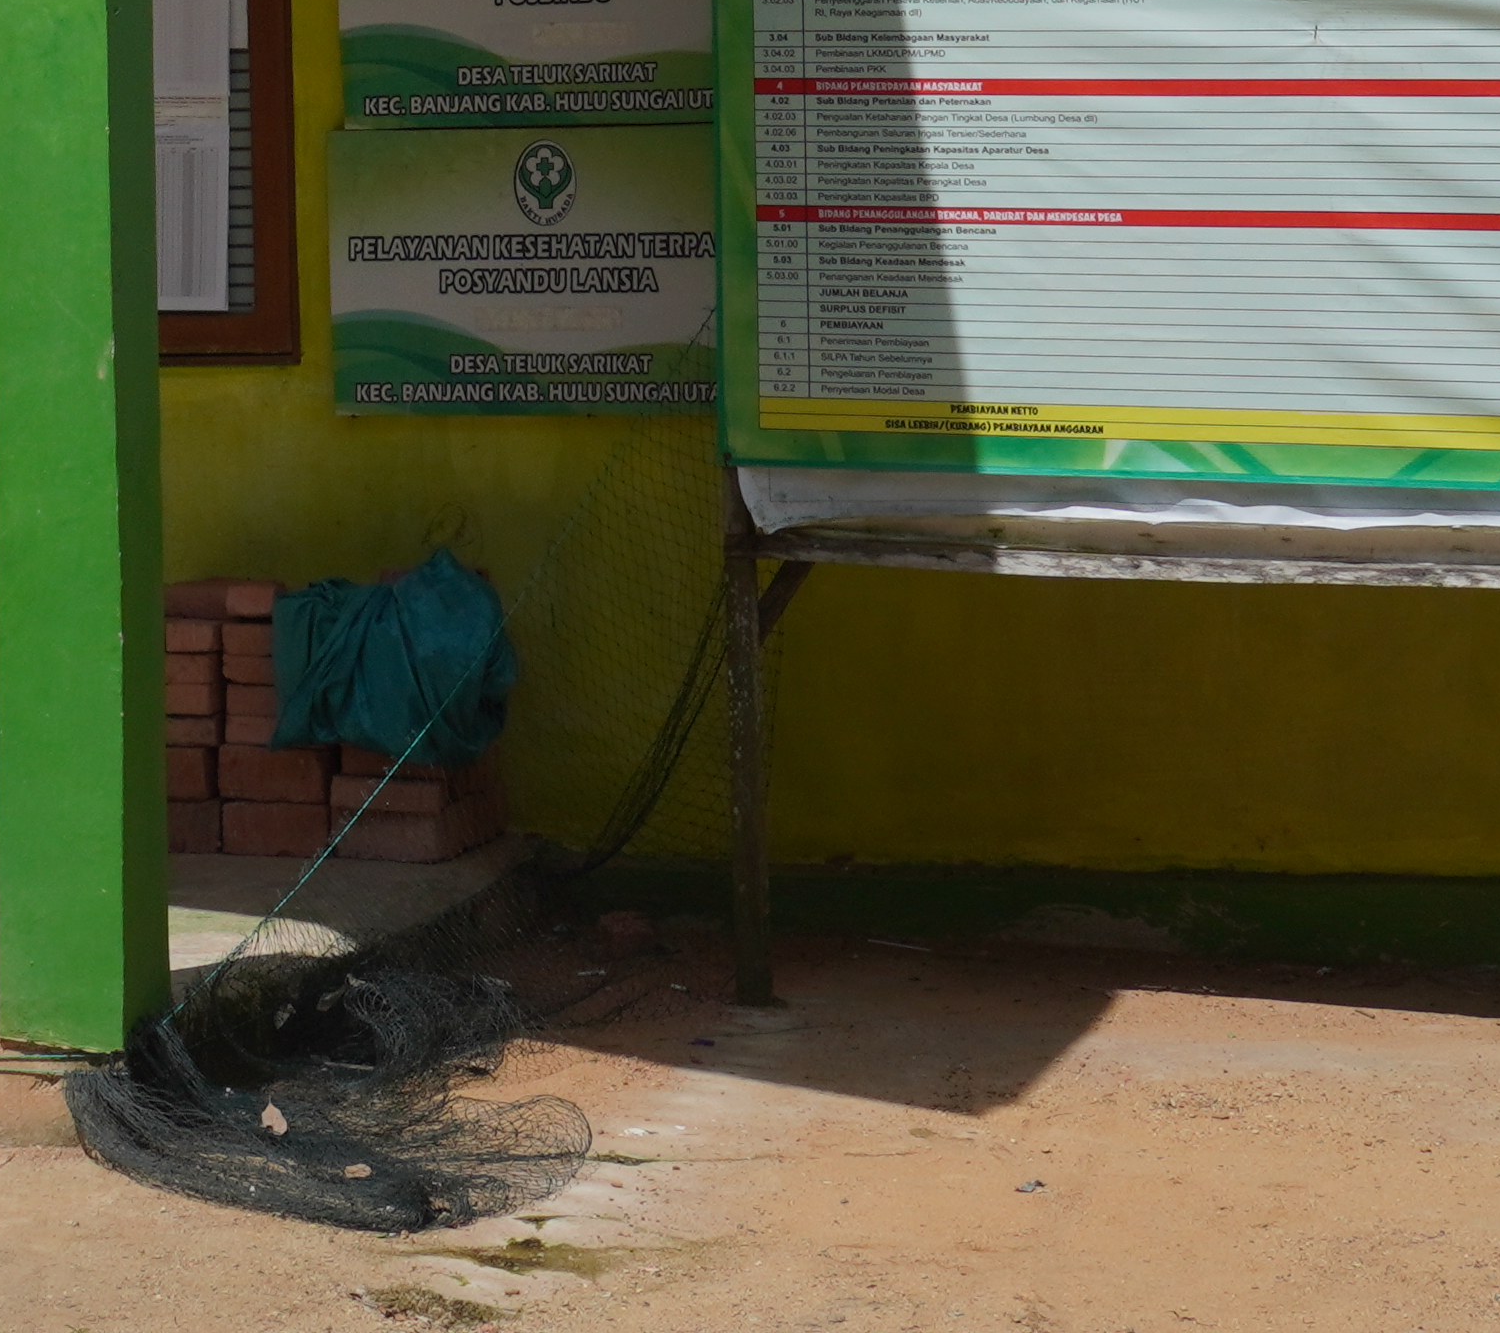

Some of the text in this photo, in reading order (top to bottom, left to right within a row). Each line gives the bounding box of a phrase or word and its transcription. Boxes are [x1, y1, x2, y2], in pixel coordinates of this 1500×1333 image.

[457, 62, 657, 87] DESA TELUK SARIKAT
[439, 267, 659, 294] POSYANDU LANSIA
[819, 289, 908, 299] JUMLAH BELANJA
[820, 305, 906, 315] SURPLUS DEFISIT
[820, 320, 883, 330] PEMBIAYAAN
